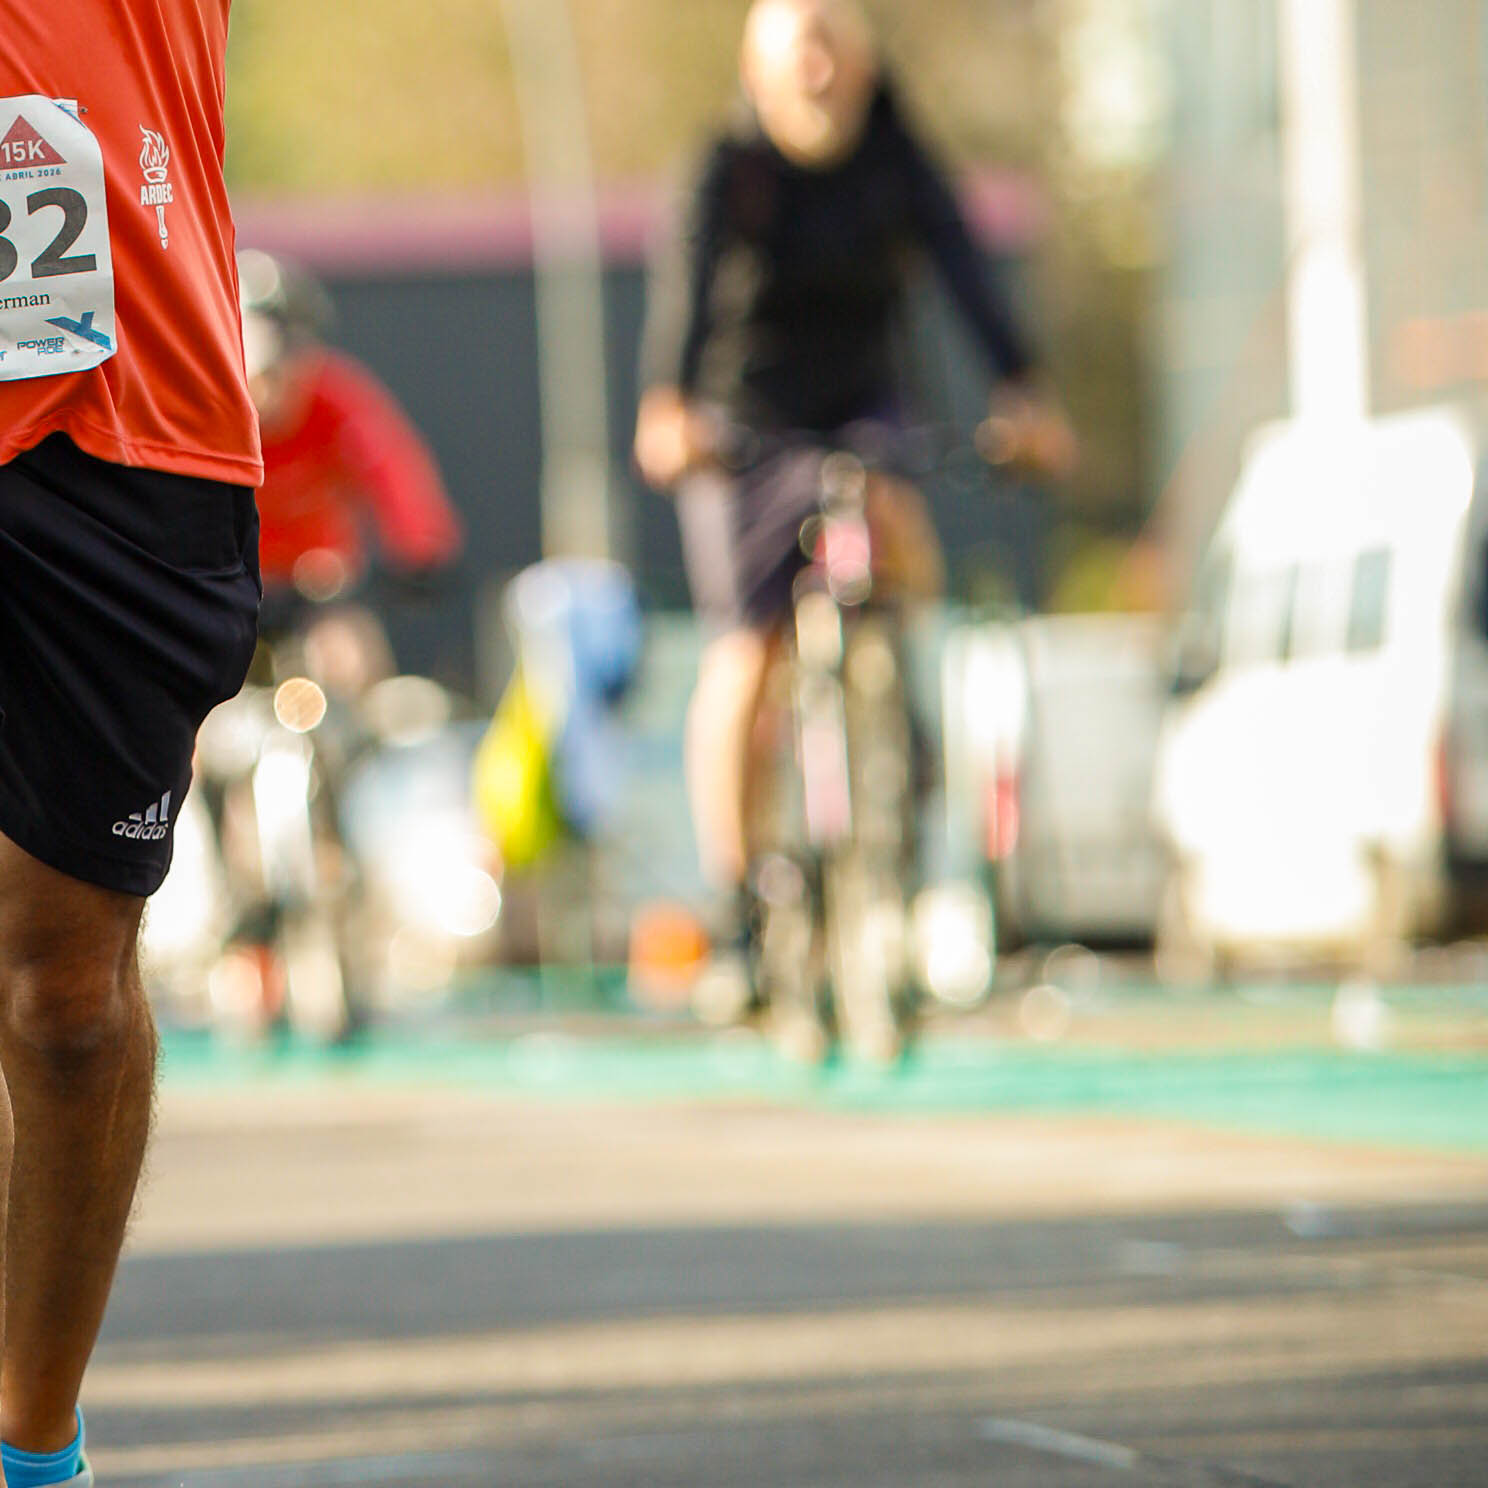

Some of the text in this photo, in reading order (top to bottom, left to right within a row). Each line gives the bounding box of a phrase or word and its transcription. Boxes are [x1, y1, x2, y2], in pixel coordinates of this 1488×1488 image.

[0, 138, 46, 163] 15K
[5, 170, 34, 180] ABRIL
[38, 167, 62, 177] 2026
[140, 183, 174, 206] ARDEC
[17, 336, 65, 350] POWER
